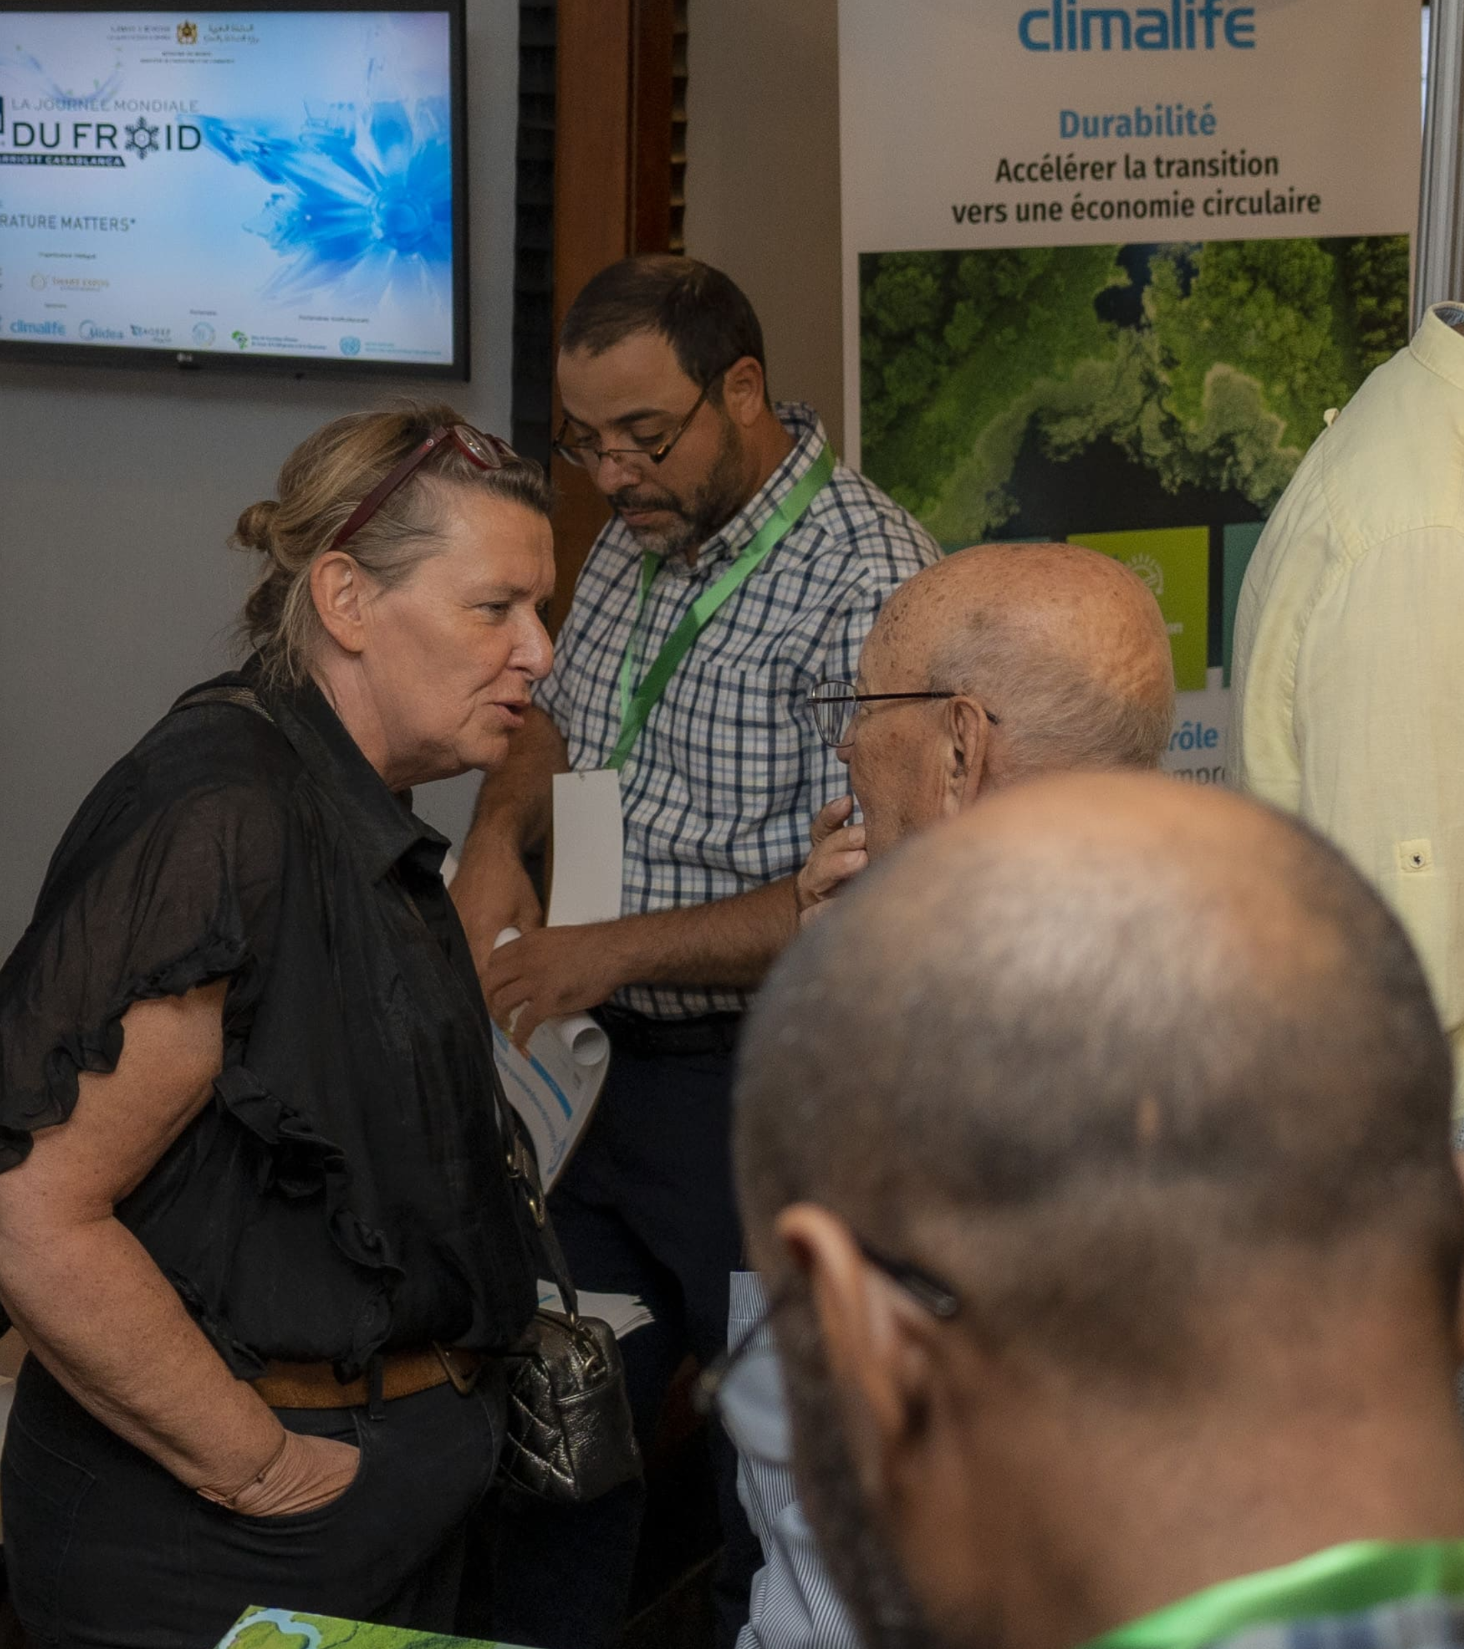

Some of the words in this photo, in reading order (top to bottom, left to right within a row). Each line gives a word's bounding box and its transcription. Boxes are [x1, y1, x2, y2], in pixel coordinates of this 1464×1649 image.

[12, 122, 61, 148] DU
[1058, 103, 1218, 140] Durabilité
[995, 152, 1118, 184] Accélérer
[1123, 154, 1147, 181] la
[1154, 148, 1280, 180] transition
[951, 200, 1009, 225] vers
[1015, 199, 1063, 224] une
[1070, 191, 1196, 222] économie
[1202, 186, 1322, 218] circulaire
